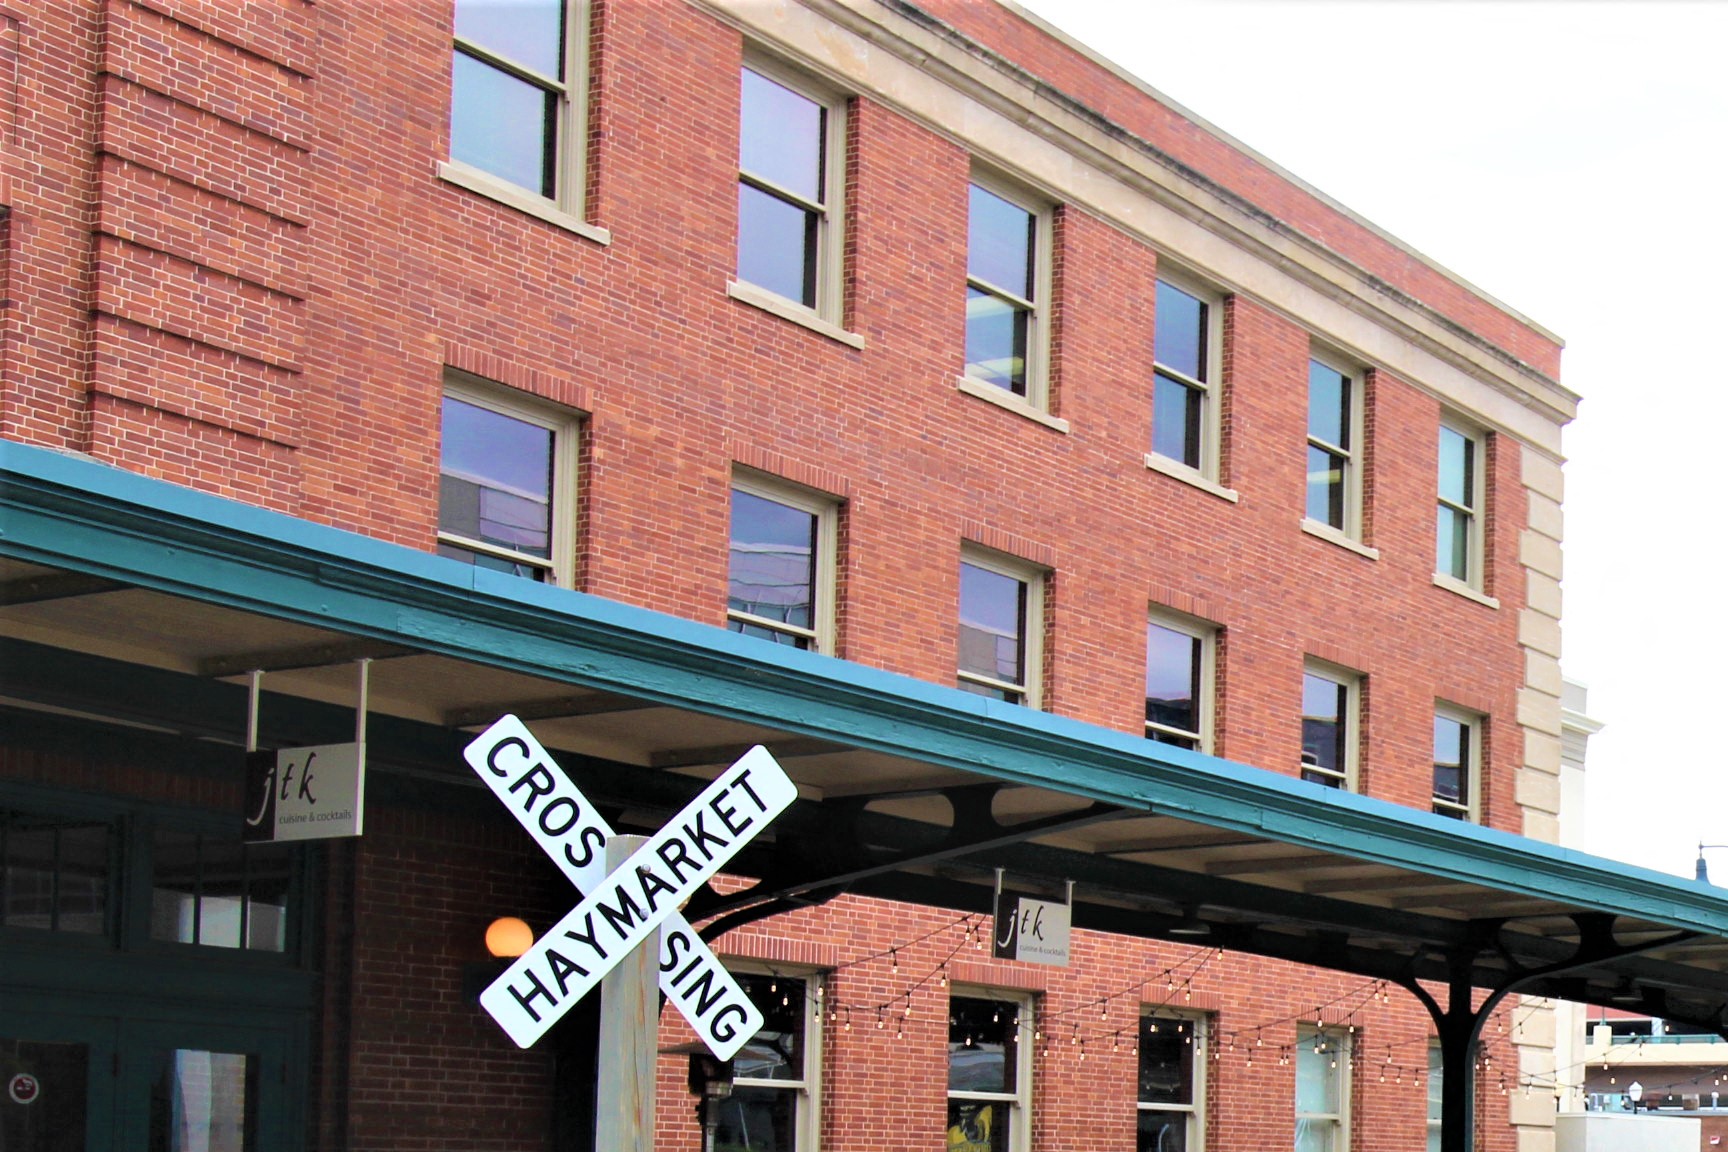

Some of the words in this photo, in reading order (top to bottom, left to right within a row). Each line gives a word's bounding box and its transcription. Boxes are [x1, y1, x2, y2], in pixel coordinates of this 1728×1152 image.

[247, 752, 316, 826] jtk
[279, 813, 307, 824] cuisine
[309, 812, 315, 822] &
[317, 809, 352, 822] cocktails
[486, 736, 606, 869] CROS
[506, 768, 768, 1023] HAYMARKET
[998, 905, 1044, 948] jtk
[659, 931, 748, 1043] SING
